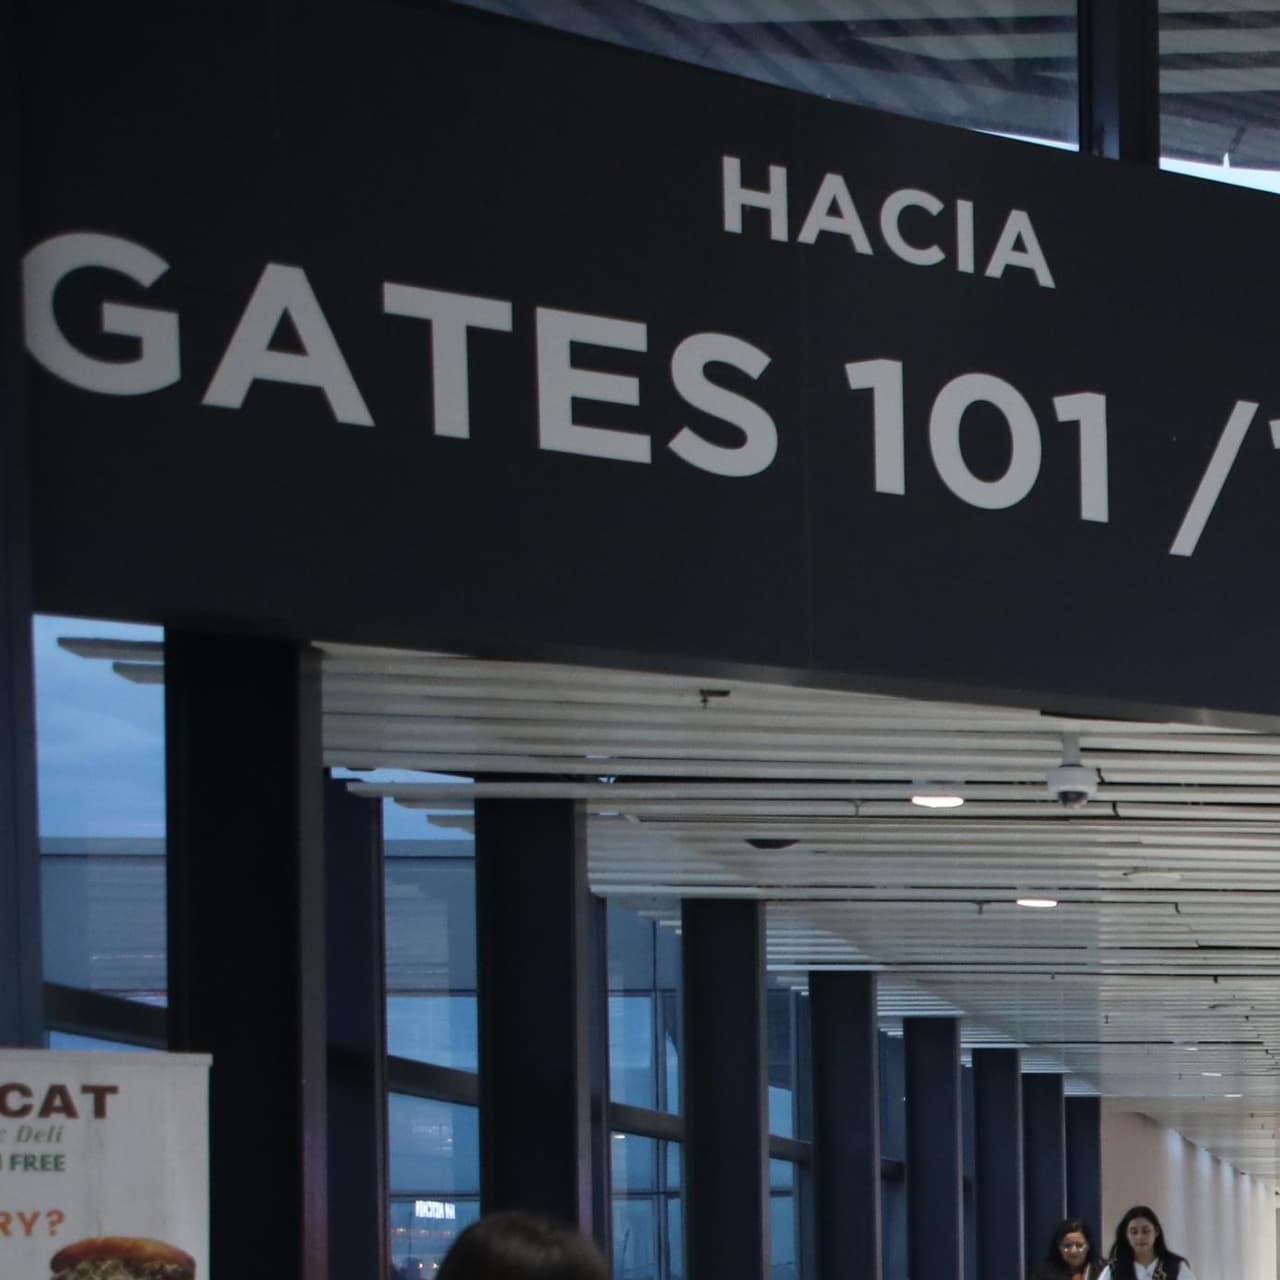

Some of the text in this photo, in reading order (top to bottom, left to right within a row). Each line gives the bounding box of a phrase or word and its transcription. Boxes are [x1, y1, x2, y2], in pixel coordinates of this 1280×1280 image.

[722, 154, 1057, 289] HACIA
[20, 231, 779, 478] GATES
[844, 357, 1110, 524] 101
[0, 1082, 119, 1120] CAT
[16, 1125, 65, 1144] Deli
[9, 1153, 66, 1172] FREE
